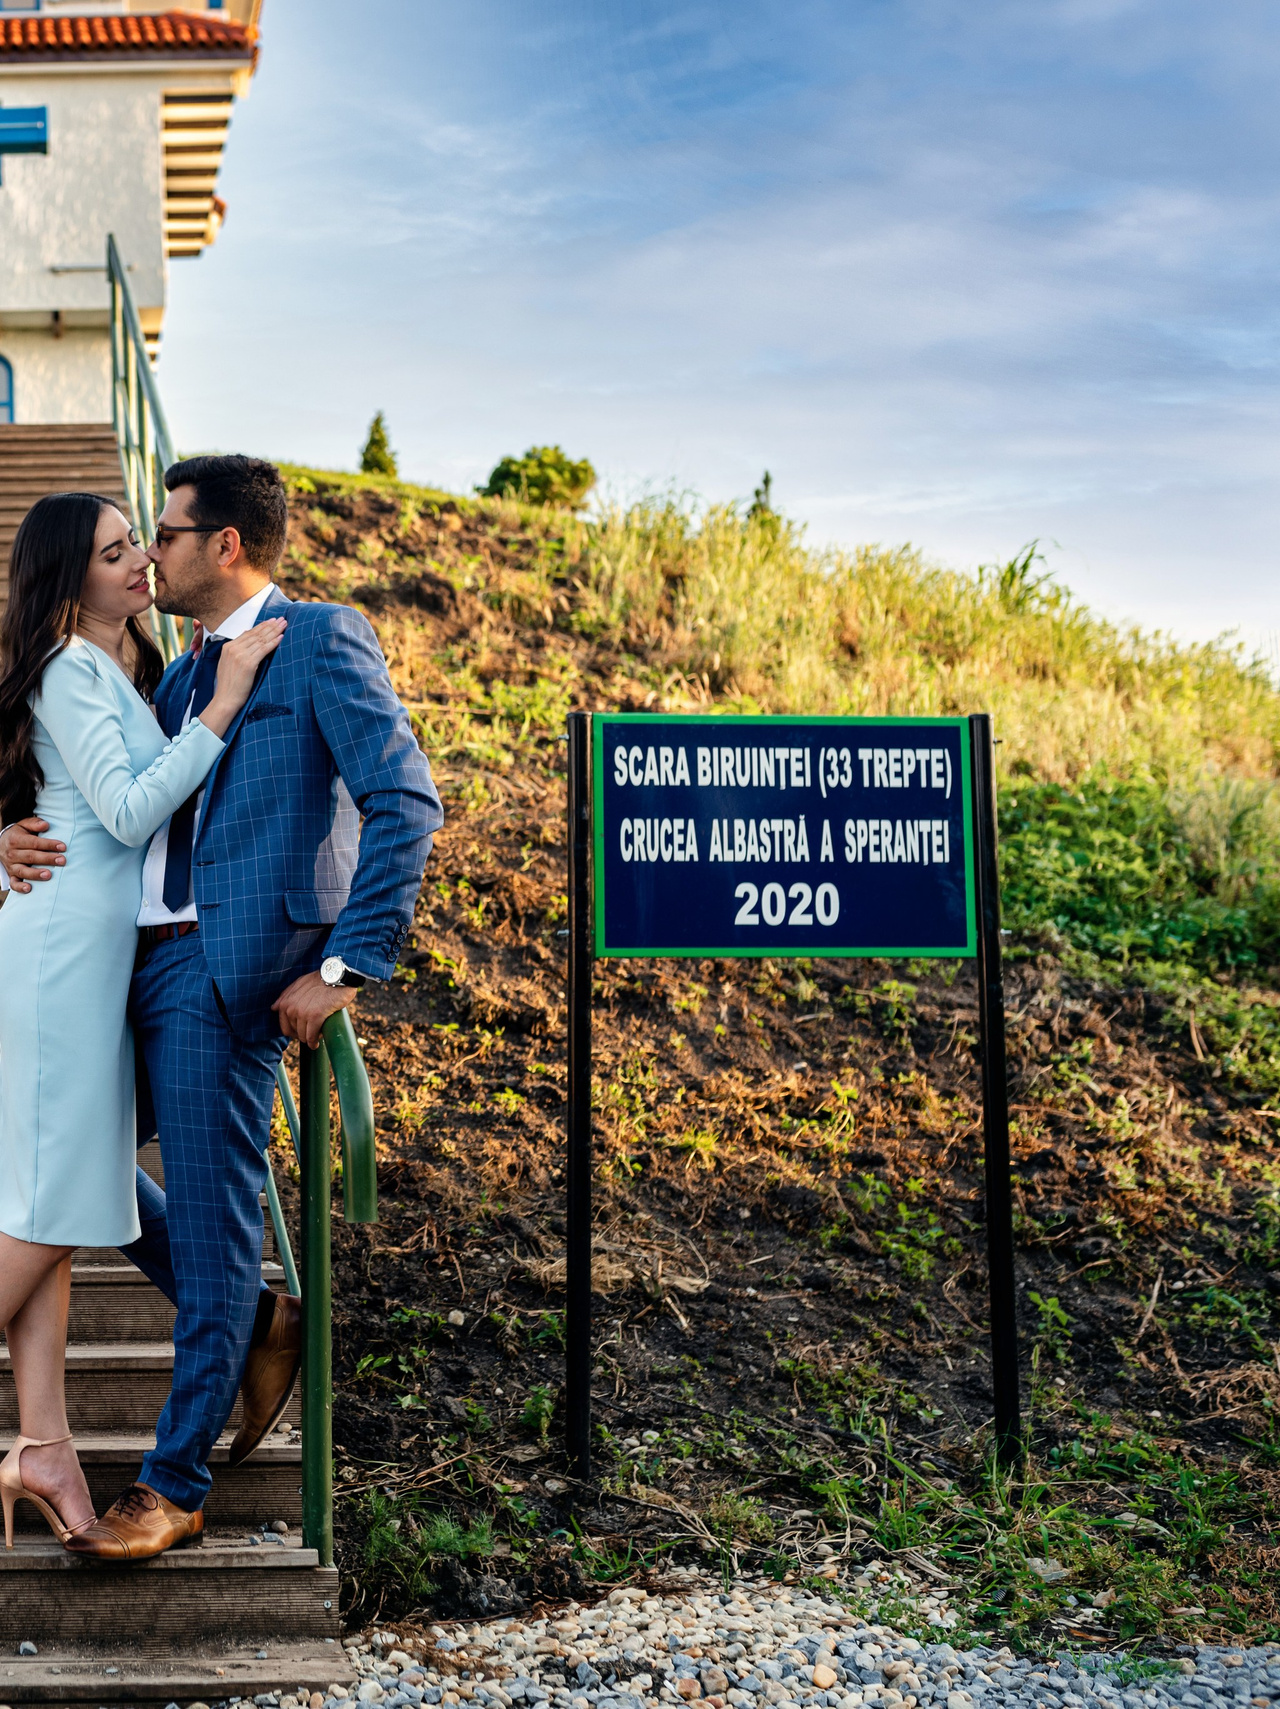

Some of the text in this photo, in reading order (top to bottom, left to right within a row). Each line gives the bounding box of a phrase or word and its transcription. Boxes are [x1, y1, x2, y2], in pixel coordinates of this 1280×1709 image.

[613, 745, 691, 787] SCARA
[818, 747, 853, 799] (33
[857, 748, 952, 800] TREPTE)
[619, 817, 699, 863] CRUCEA
[709, 814, 810, 863] ALBASTRĂ
[820, 819, 835, 863] A
[734, 882, 840, 926] 2020
